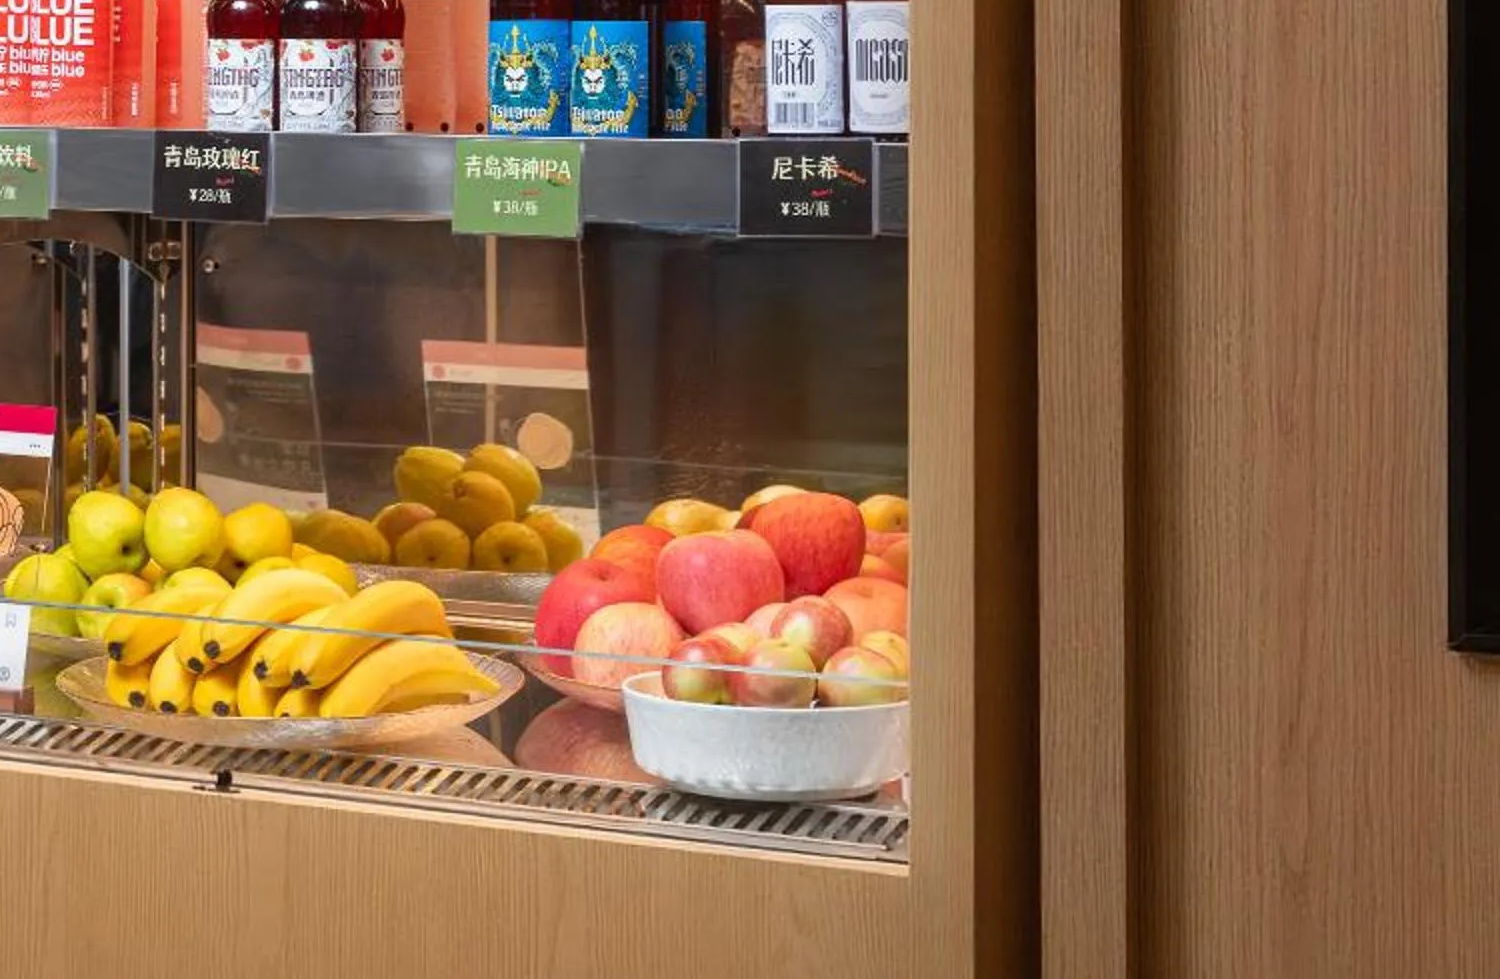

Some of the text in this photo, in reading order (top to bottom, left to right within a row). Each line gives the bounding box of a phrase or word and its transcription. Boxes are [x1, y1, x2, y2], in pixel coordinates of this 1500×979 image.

[164, 144, 260, 170] 青岛玫瑰红
[464, 154, 571, 181] 青岛海神IPA
[772, 155, 839, 180] 尼卡希
